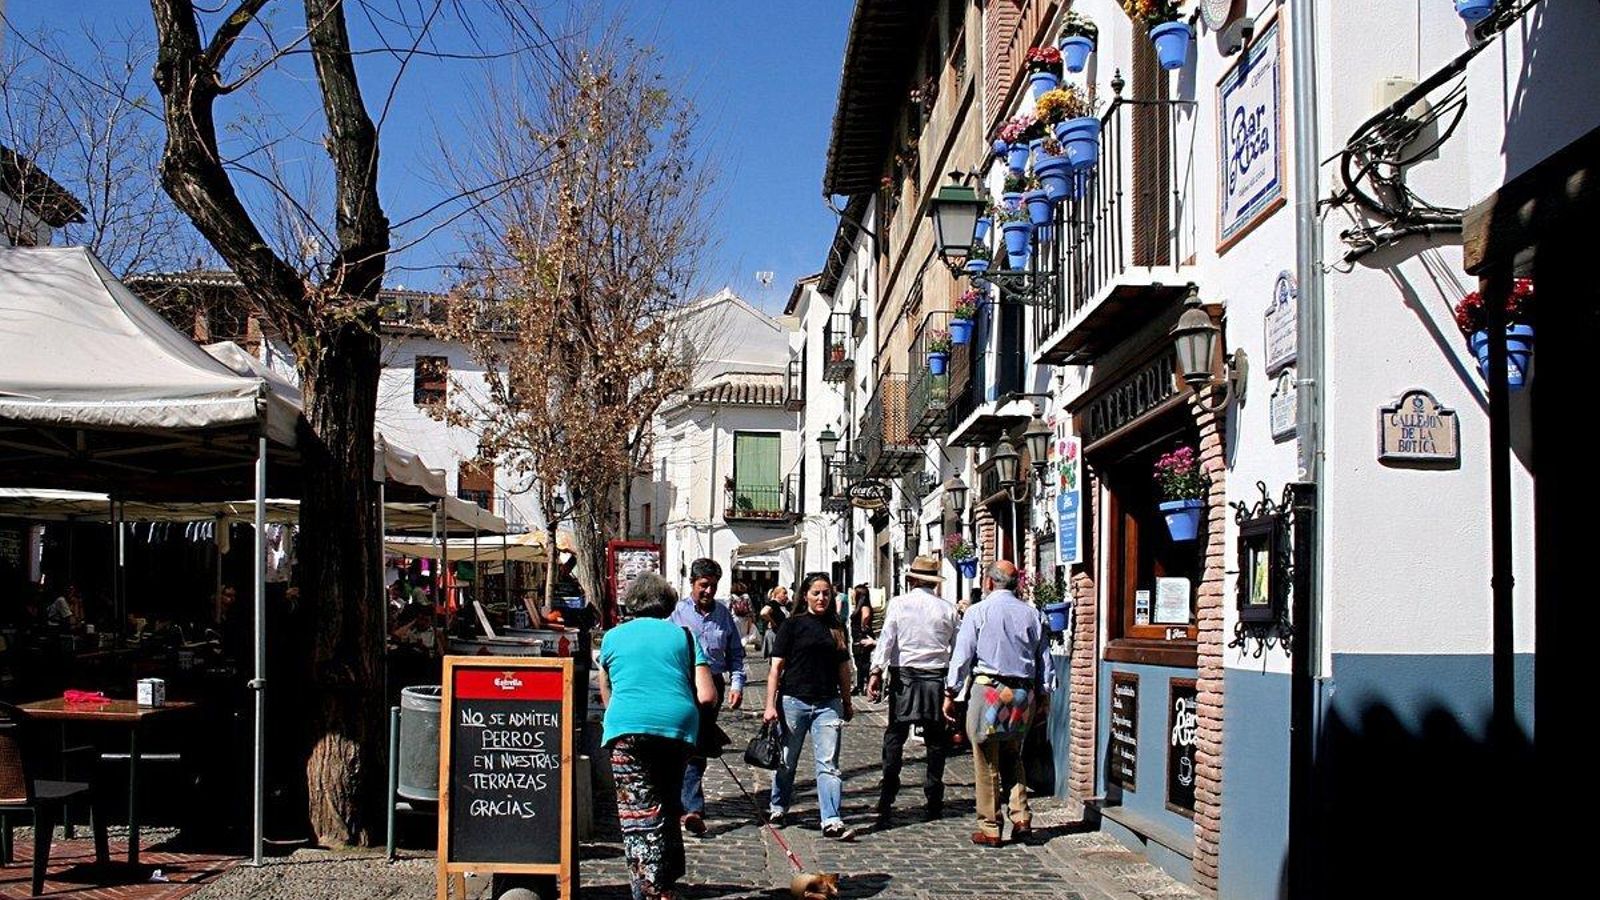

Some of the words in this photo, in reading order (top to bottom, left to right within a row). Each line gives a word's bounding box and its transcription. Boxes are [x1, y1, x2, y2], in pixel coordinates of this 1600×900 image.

[1231, 104, 1266, 147] Bar
[1401, 427, 1415, 440] DE
[1419, 428, 1434, 440] LA
[1398, 439, 1438, 454] BOTICA
[461, 708, 485, 726] NO
[489, 713, 505, 725] SE
[509, 710, 559, 727] ADMITEN
[481, 731, 545, 749] PERROS
[474, 755, 494, 770] EN
[500, 754, 560, 770] NUESTRAS
[469, 773, 547, 790] TERRAZAS
[470, 798, 535, 818] GRACIAS
